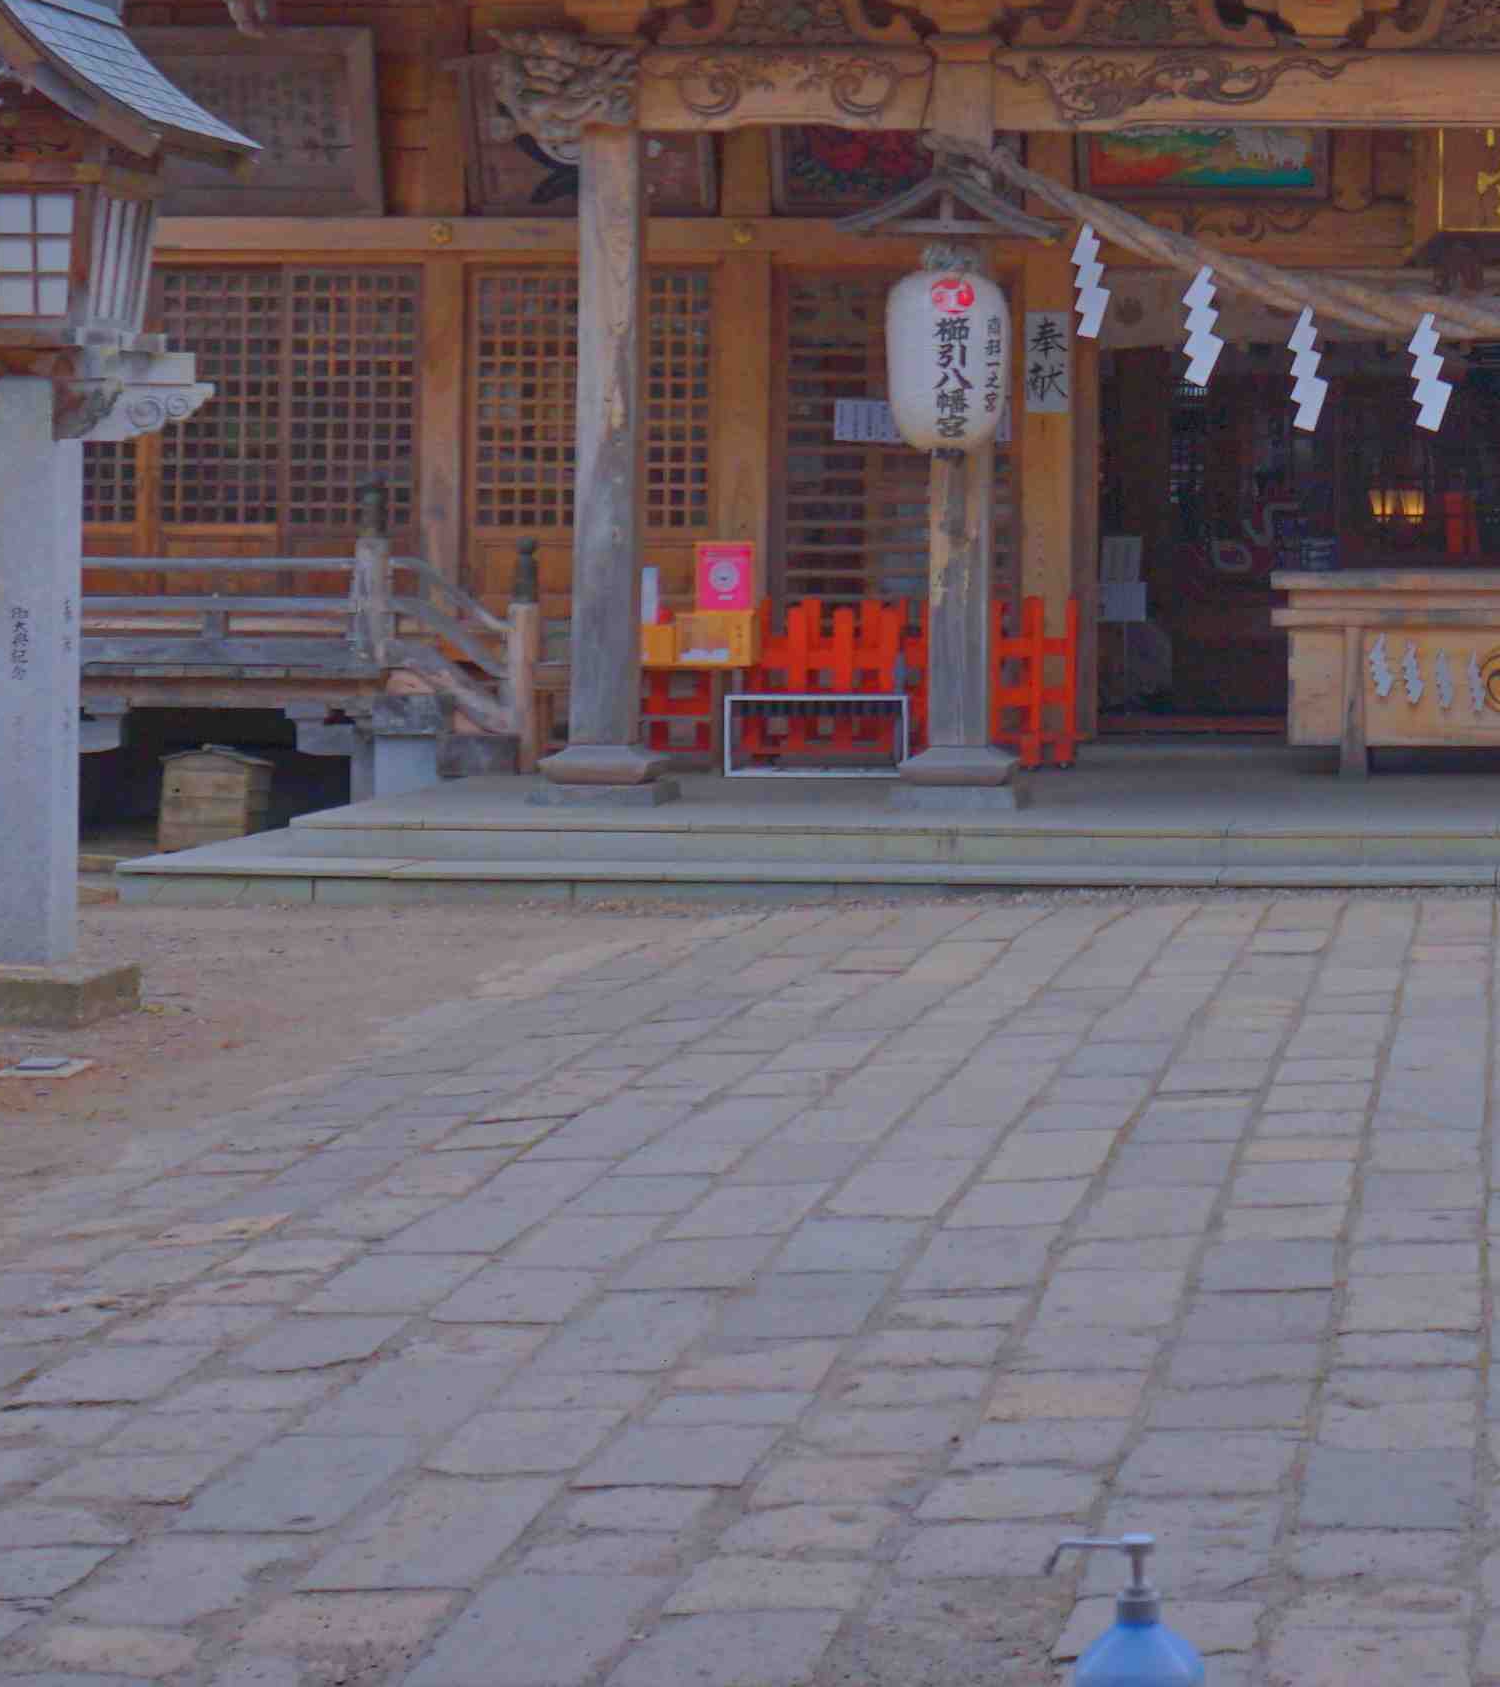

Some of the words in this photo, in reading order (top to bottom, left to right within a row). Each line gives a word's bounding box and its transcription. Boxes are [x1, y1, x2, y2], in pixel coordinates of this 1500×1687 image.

[933, 316, 973, 438] 櫛引八幡宮
[1027, 316, 1068, 402] 奉献
